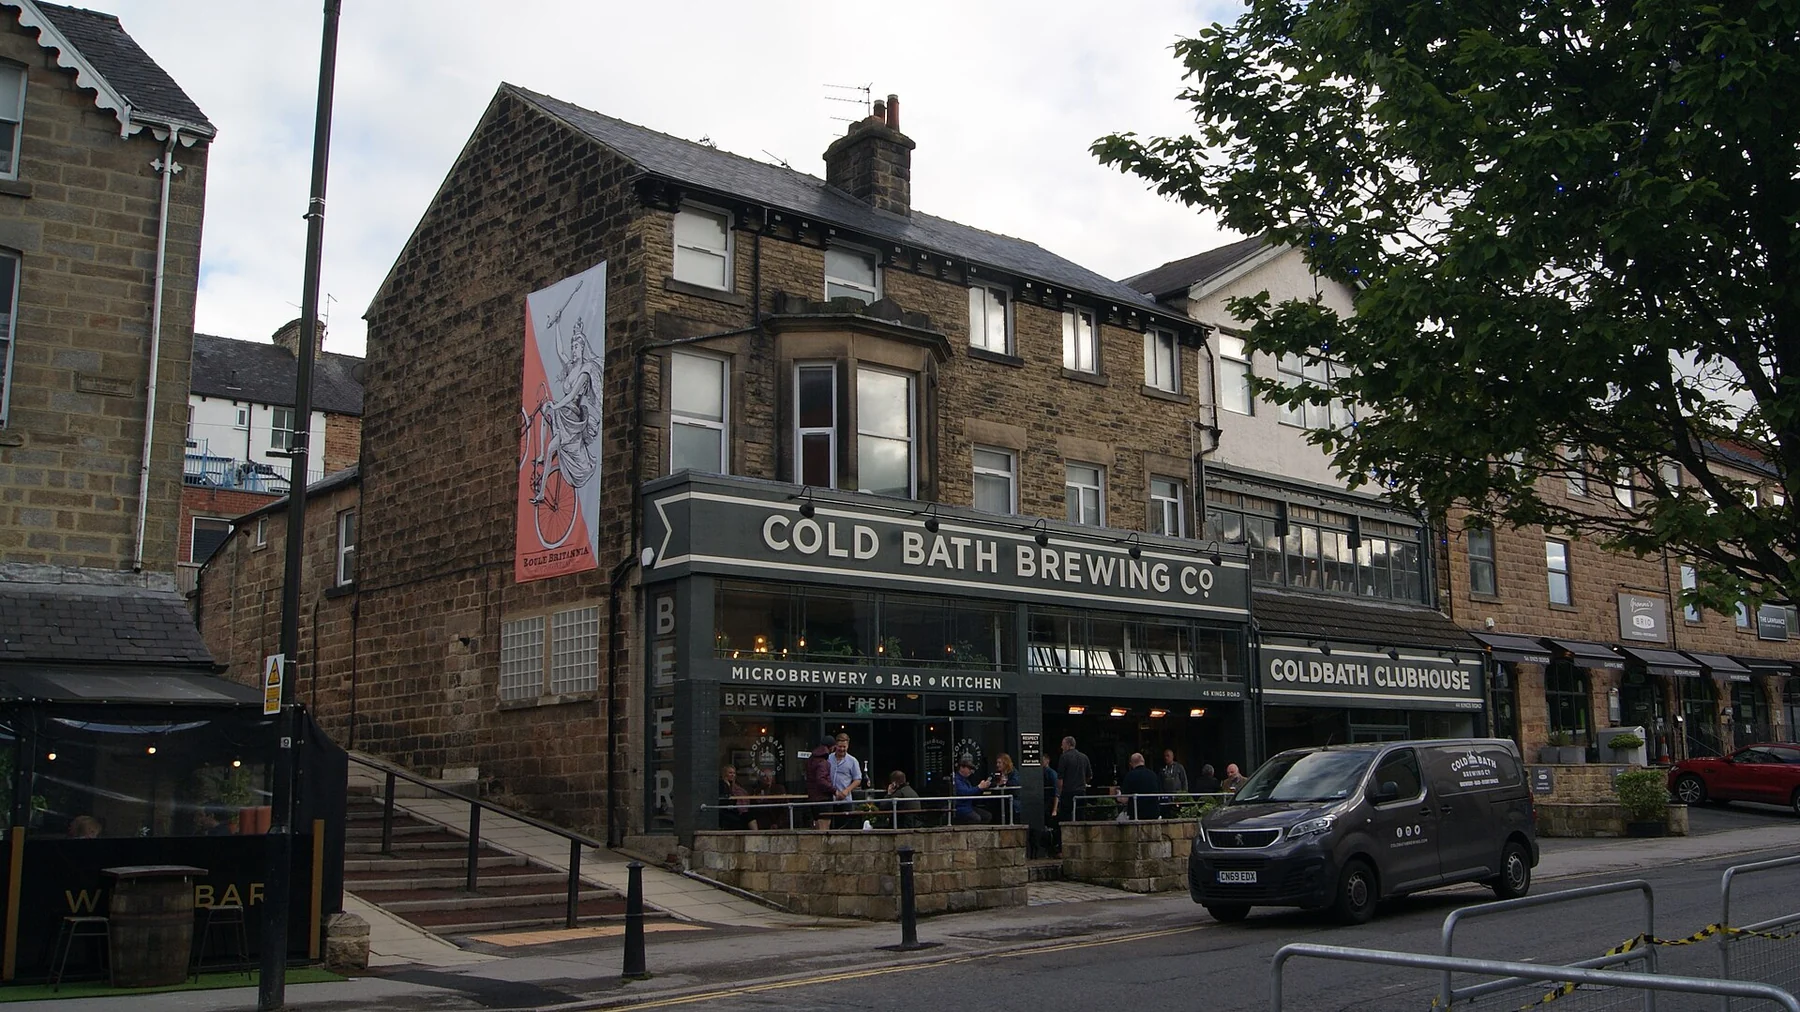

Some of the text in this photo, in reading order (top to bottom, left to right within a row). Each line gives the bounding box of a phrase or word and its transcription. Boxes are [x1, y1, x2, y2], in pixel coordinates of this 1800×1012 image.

[548, 546, 589, 563] BRITANNIA
[763, 513, 879, 561] COLD
[903, 530, 998, 575] BATH
[1016, 544, 1170, 594] BREWING
[1635, 617, 1652, 627] BRIO
[732, 665, 1002, 690] MICROBREWERY BAR KITCHEN
[1270, 658, 1471, 692] COLDBATH CLUBHOUSE
[655, 597, 675, 808] BEER
[725, 693, 808, 708] BREWERY
[848, 696, 897, 711] FRESH
[949, 699, 984, 712] BEER
[750, 735, 785, 757] COLD BATH
[954, 738, 967, 758] COLD
[967, 737, 982, 757] BATH
[1451, 755, 1497, 772] COLD BATH
[1462, 769, 1485, 778] BREWING
[1221, 872, 1255, 881] CN69 EDX
